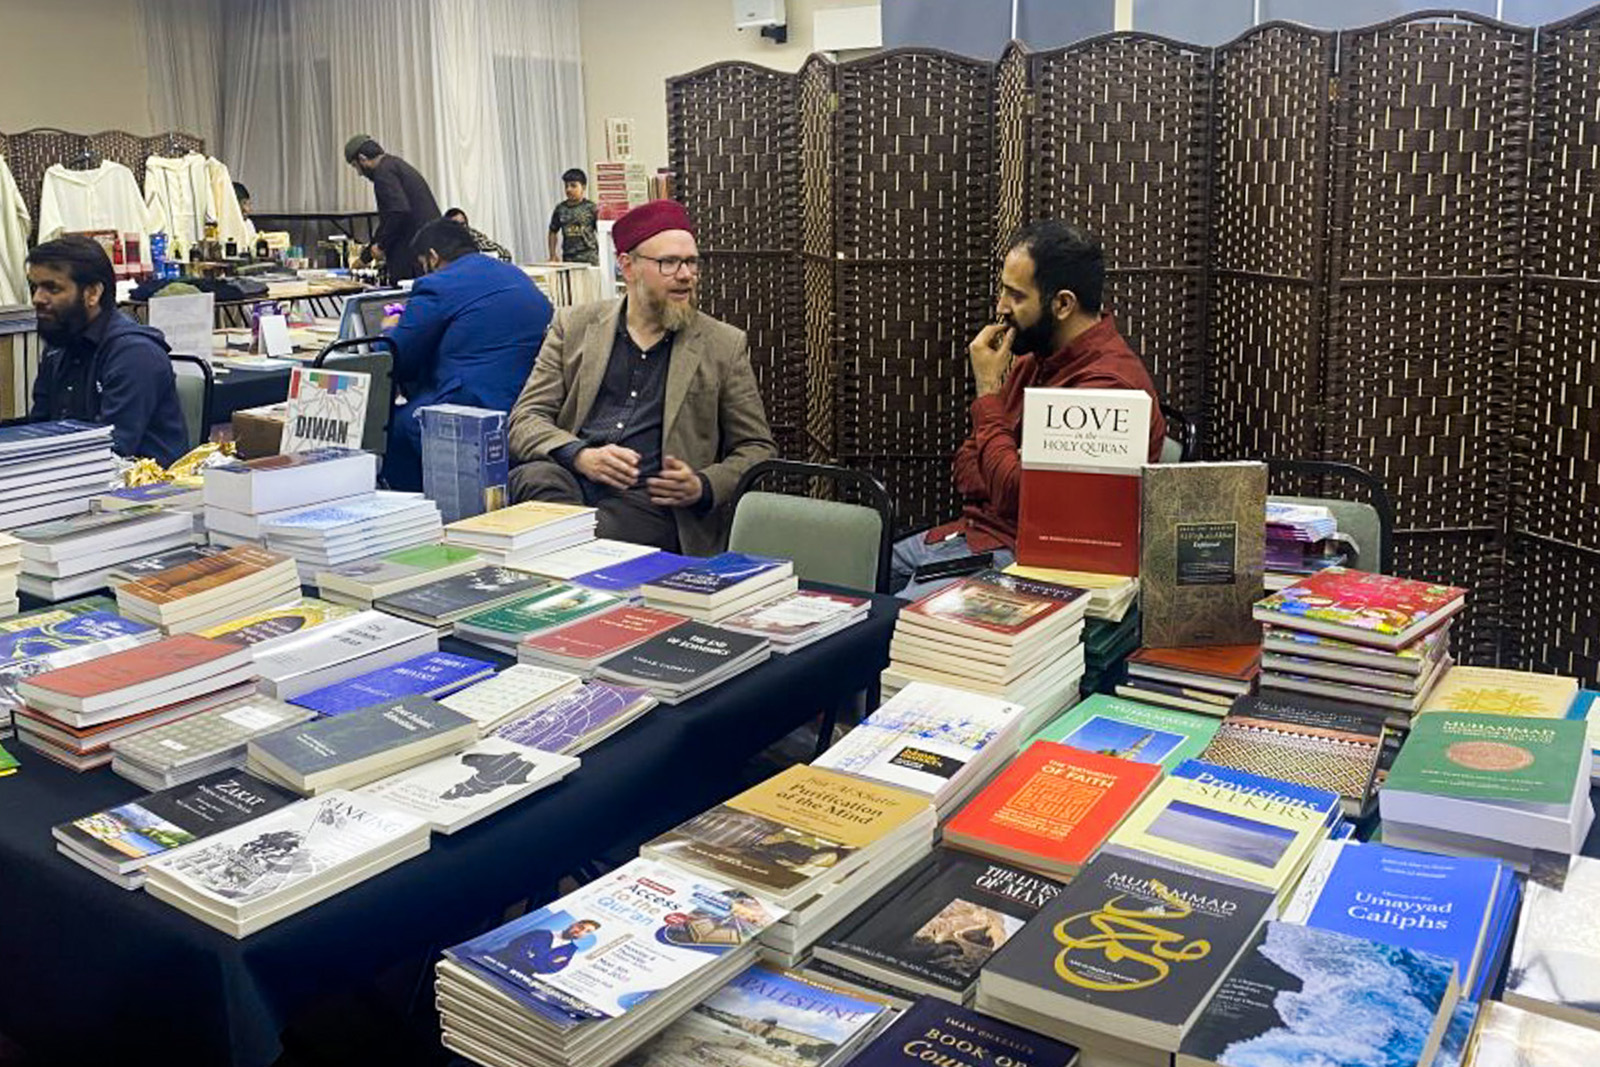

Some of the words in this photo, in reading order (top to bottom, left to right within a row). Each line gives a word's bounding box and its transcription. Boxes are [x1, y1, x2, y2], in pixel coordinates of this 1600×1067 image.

[295, 416, 349, 444] DIWAN
[1046, 404, 1129, 433] LOVE
[1043, 439, 1079, 451] HOLY
[1041, 764, 1064, 777] OF
[1066, 770, 1115, 789] FAITH
[789, 783, 883, 817] Purification
[1194, 771, 1319, 812] Provisions
[1200, 785, 1312, 823] SEEKERS
[796, 797, 822, 810] the
[824, 805, 873, 824] Mind
[986, 865, 1017, 880] THE
[623, 884, 682, 910] Access
[976, 876, 1004, 888] OF
[1000, 884, 1050, 907] MAN
[1356, 891, 1453, 913] Umayyad
[1347, 905, 1449, 930] Caliphs
[740, 977, 866, 1022] PALESTINE
[924, 1028, 990, 1060] BOOK
